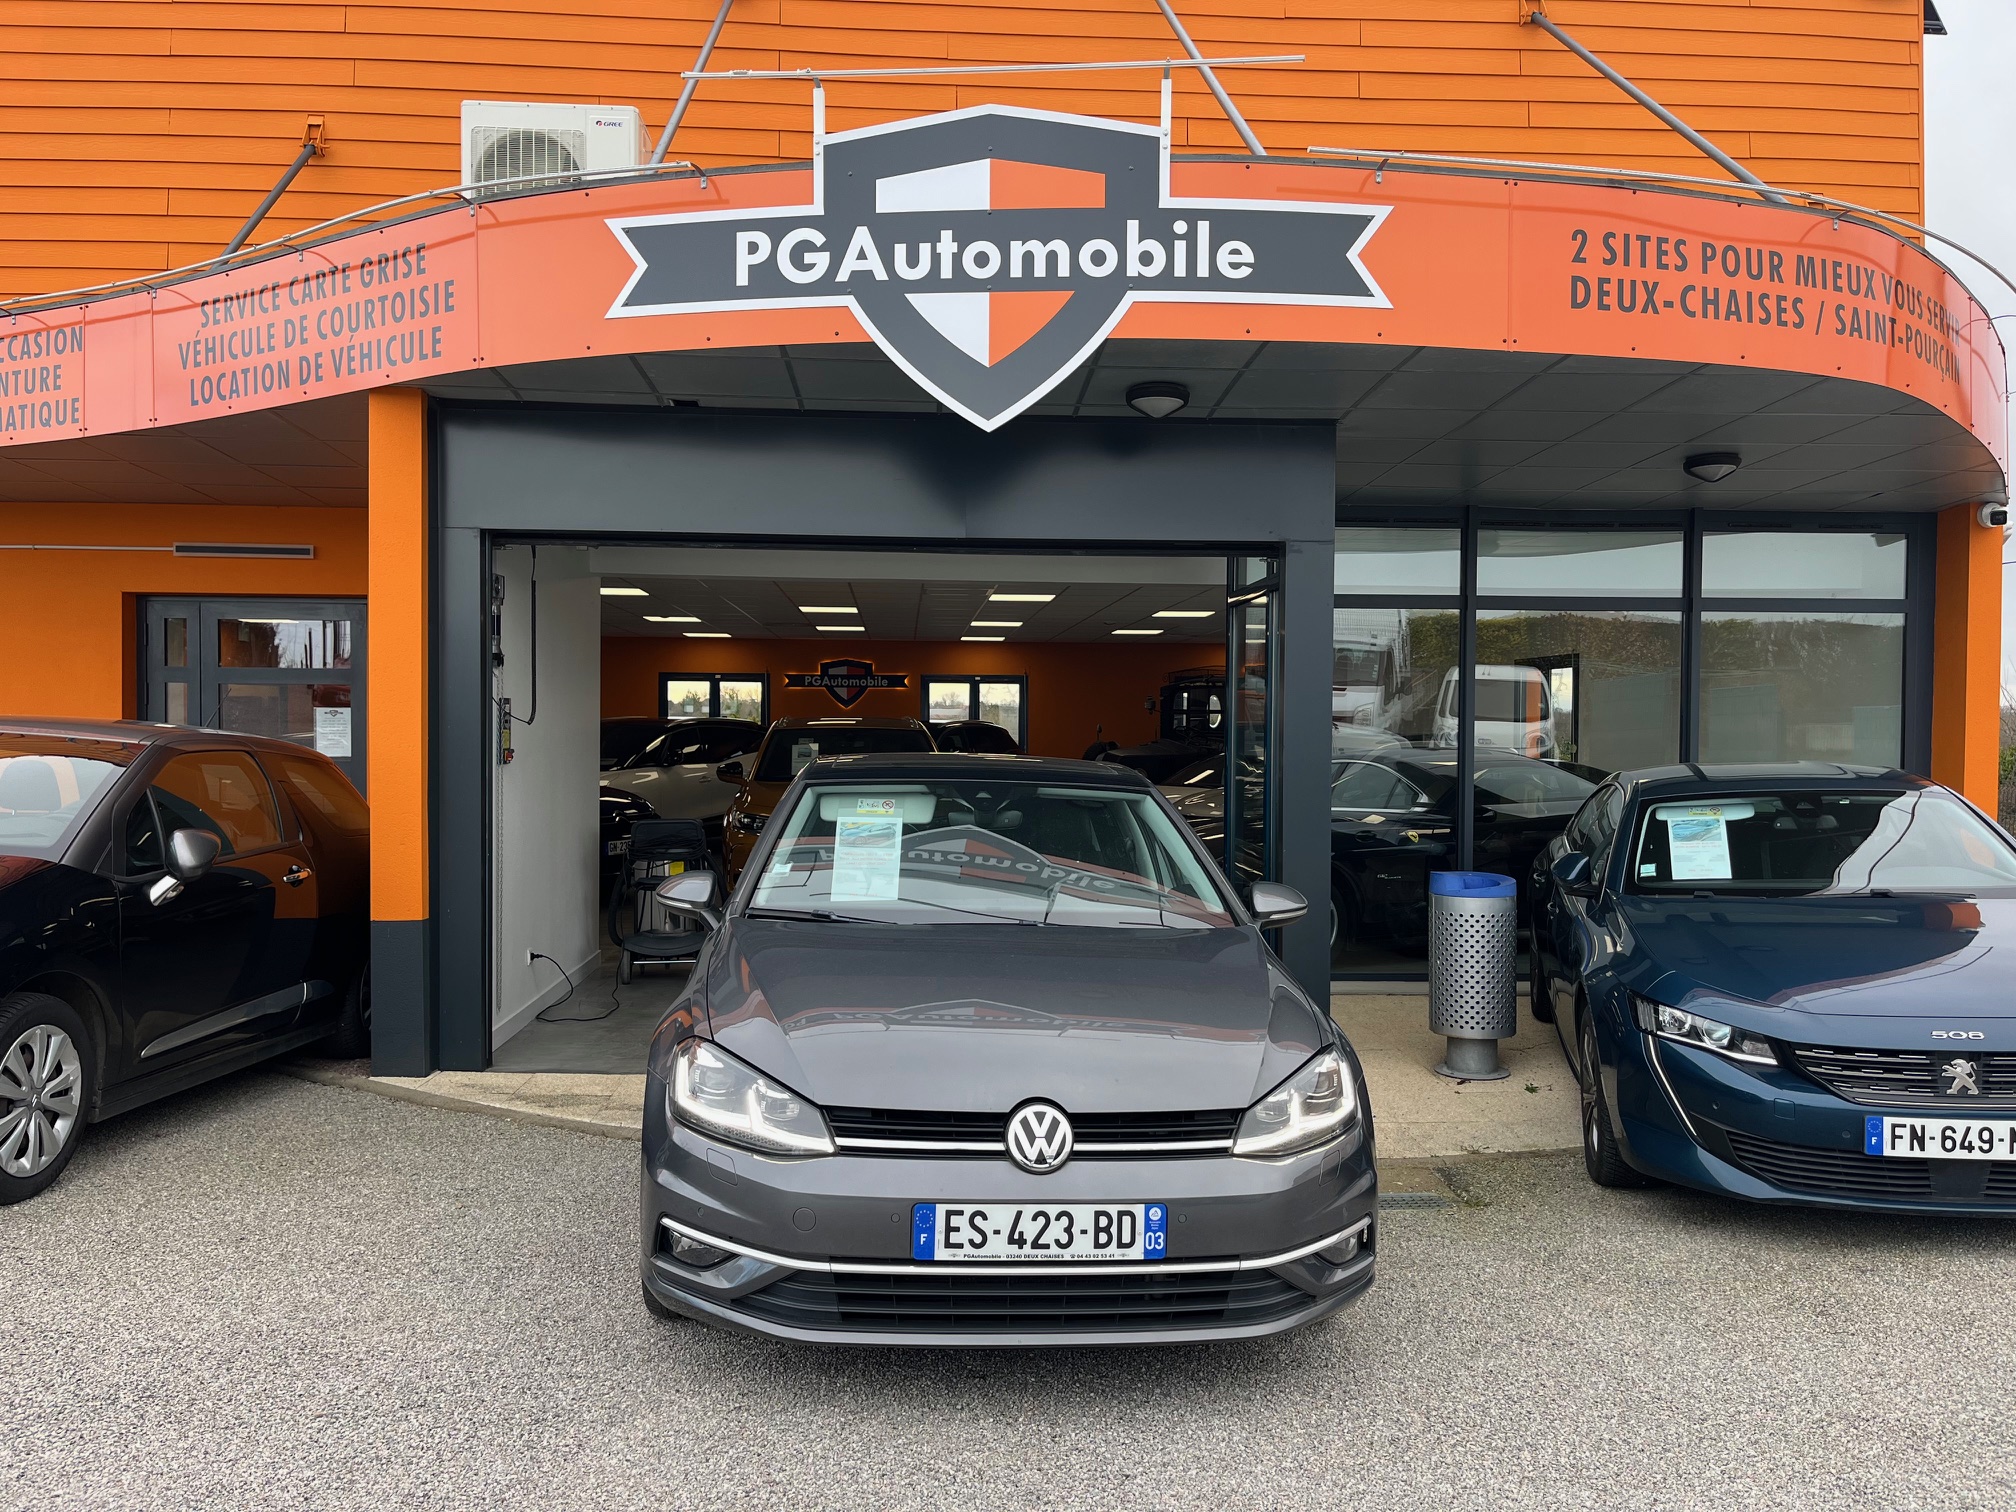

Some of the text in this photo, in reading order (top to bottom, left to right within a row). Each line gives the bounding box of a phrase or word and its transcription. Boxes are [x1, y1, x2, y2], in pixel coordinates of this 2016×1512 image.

[734, 219, 1255, 287] PGAutomobile
[200, 242, 428, 329] SERVICE CARTE GRISE
[1571, 228, 1960, 348] 2 SITES POUR MIEUX VOUS SERVIR
[178, 279, 457, 371] VÉHICULE DE COURTOISIE
[1571, 275, 1806, 330] DEUX-CHAISES
[1834, 303, 1960, 386] SAINT-POURÇAIN
[190, 326, 443, 407] LOCATION DE VÉHICULE
[0, 397, 80, 432] ATIQUE
[804, 675, 889, 687] PGAutomobile
[1930, 1030, 1985, 1040] 508
[1871, 1137, 1878, 1146] F
[920, 1233, 928, 1246] F
[943, 1209, 1137, 1250] ES-423-BD
[1145, 1231, 1164, 1250] 03
